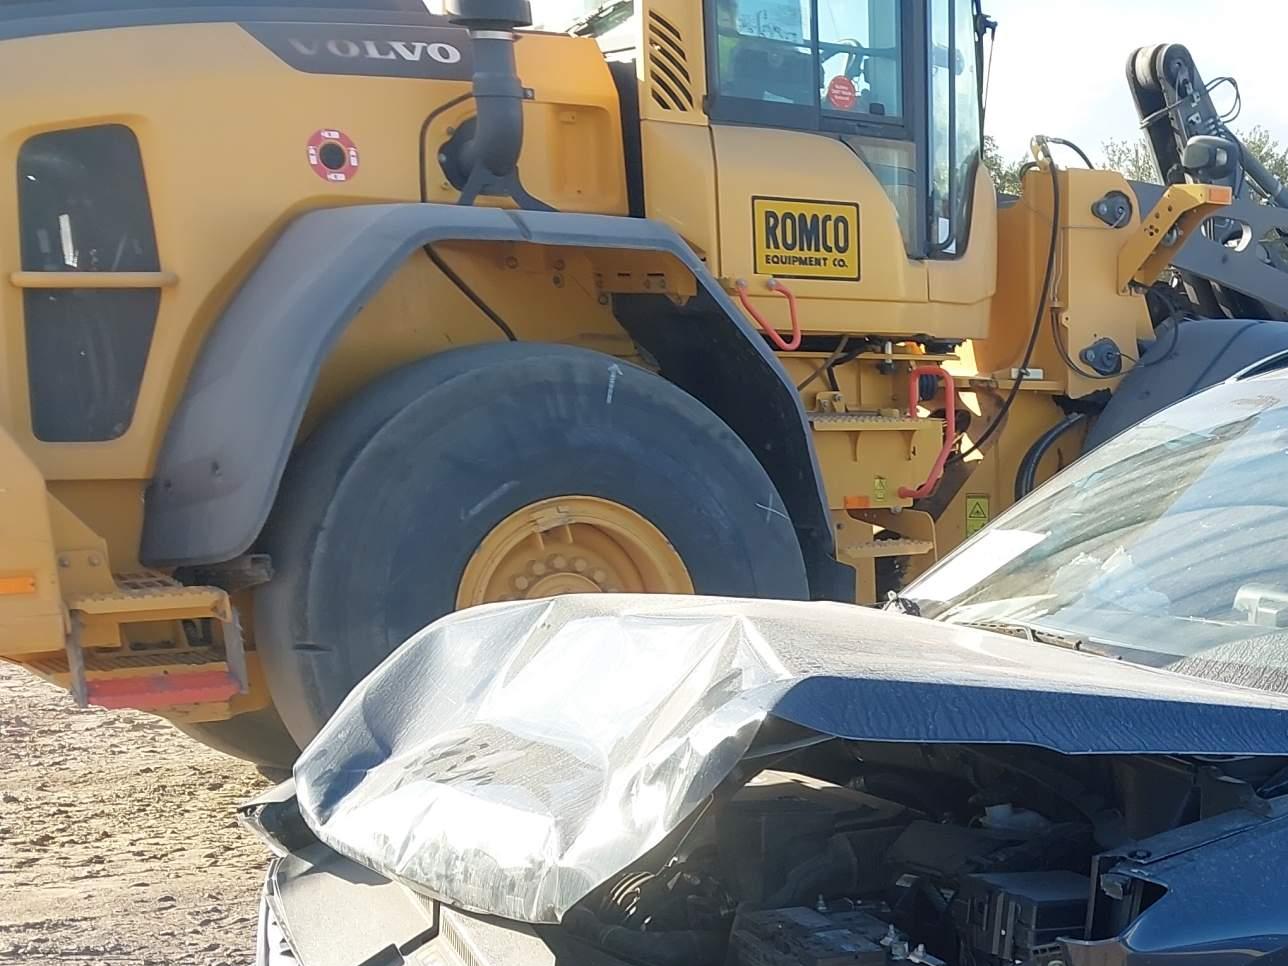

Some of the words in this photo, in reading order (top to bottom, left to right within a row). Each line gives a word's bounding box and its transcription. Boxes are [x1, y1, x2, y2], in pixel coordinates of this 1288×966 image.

[288, 39, 461, 64] VOLVO
[765, 210, 849, 253] ROMCO
[765, 255, 828, 267] EQUIPMENT
[832, 258, 848, 268] CO.
